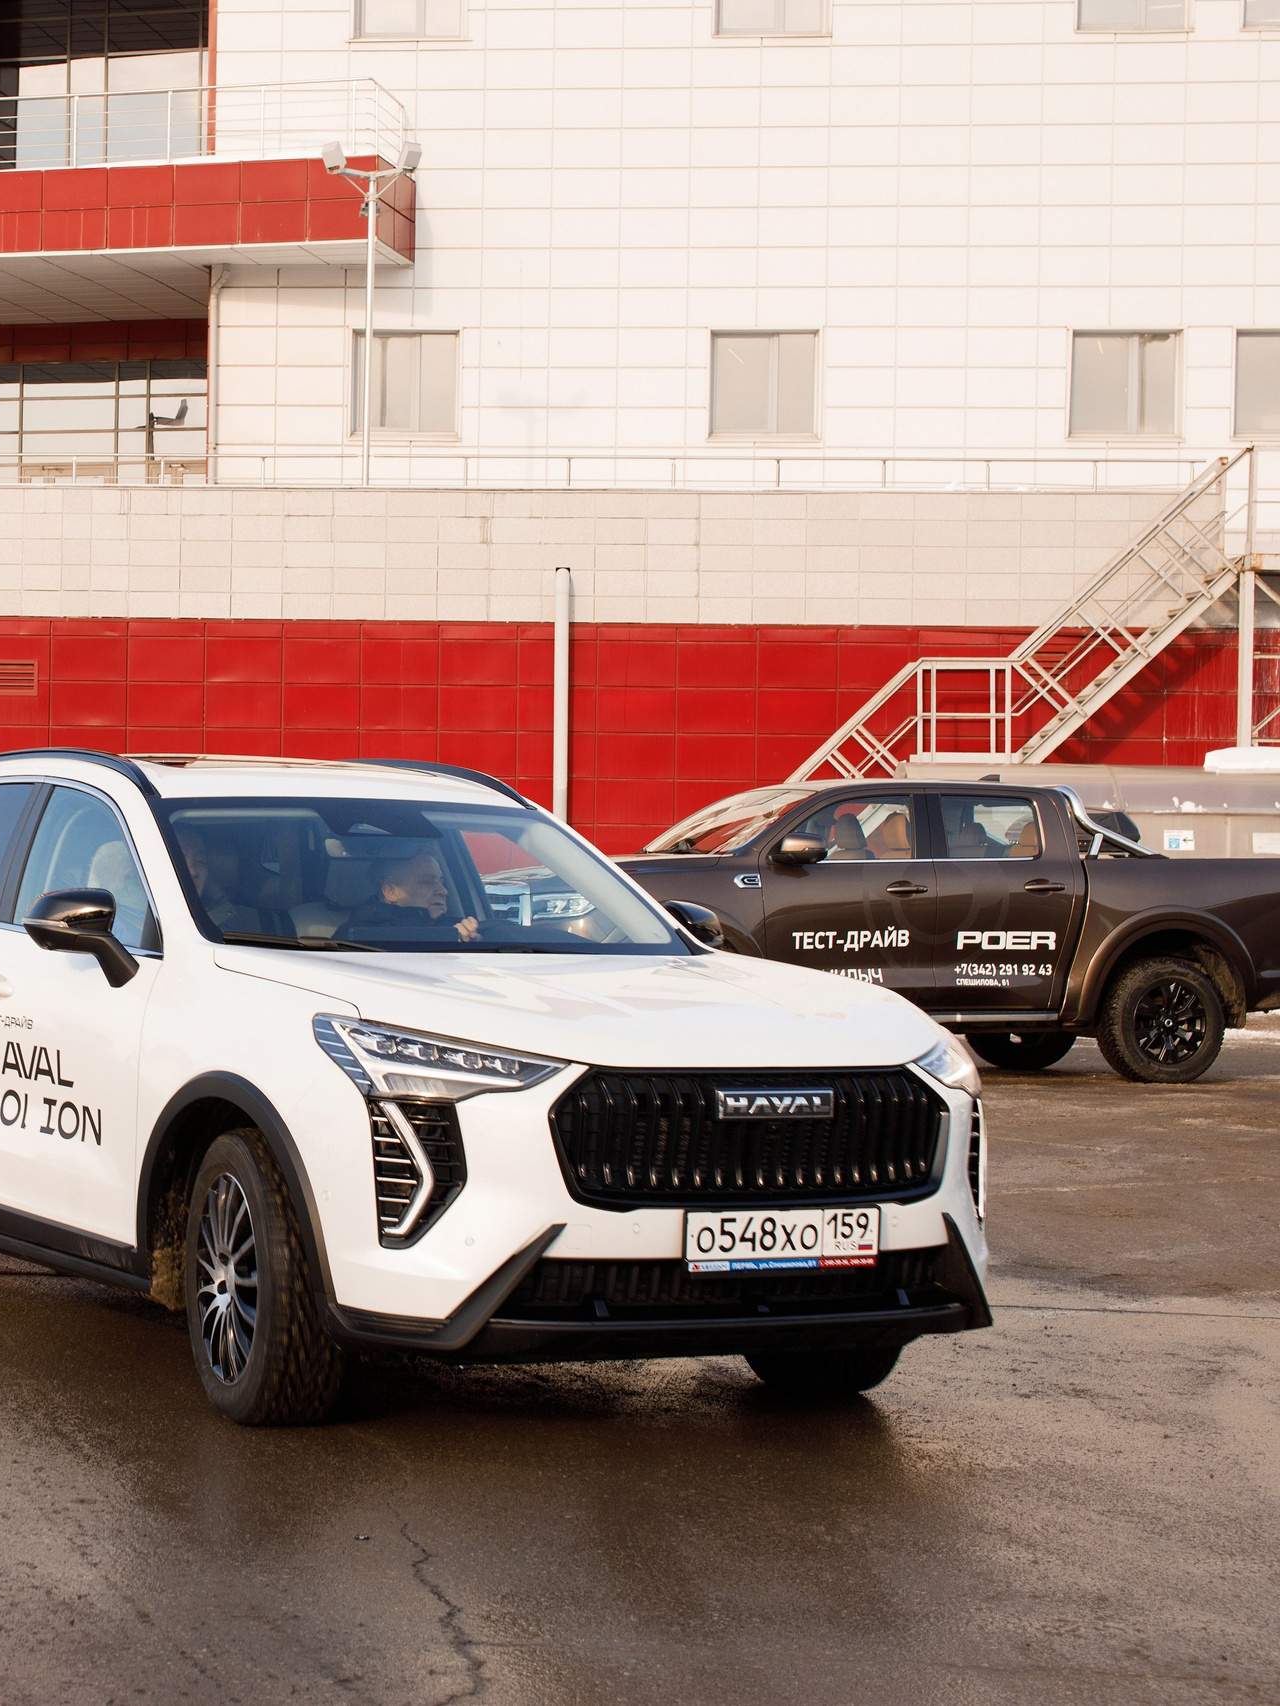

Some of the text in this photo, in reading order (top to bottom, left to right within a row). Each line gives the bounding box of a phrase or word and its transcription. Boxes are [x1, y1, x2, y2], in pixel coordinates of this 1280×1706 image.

[791, 926, 910, 952] ТЕСТ-ДРАЙВ
[956, 931, 1057, 951] POER
[954, 963, 1053, 977] +7(342) 291 92 43
[827, 1212, 869, 1239] 159
[834, 1240, 858, 1251] RUS
